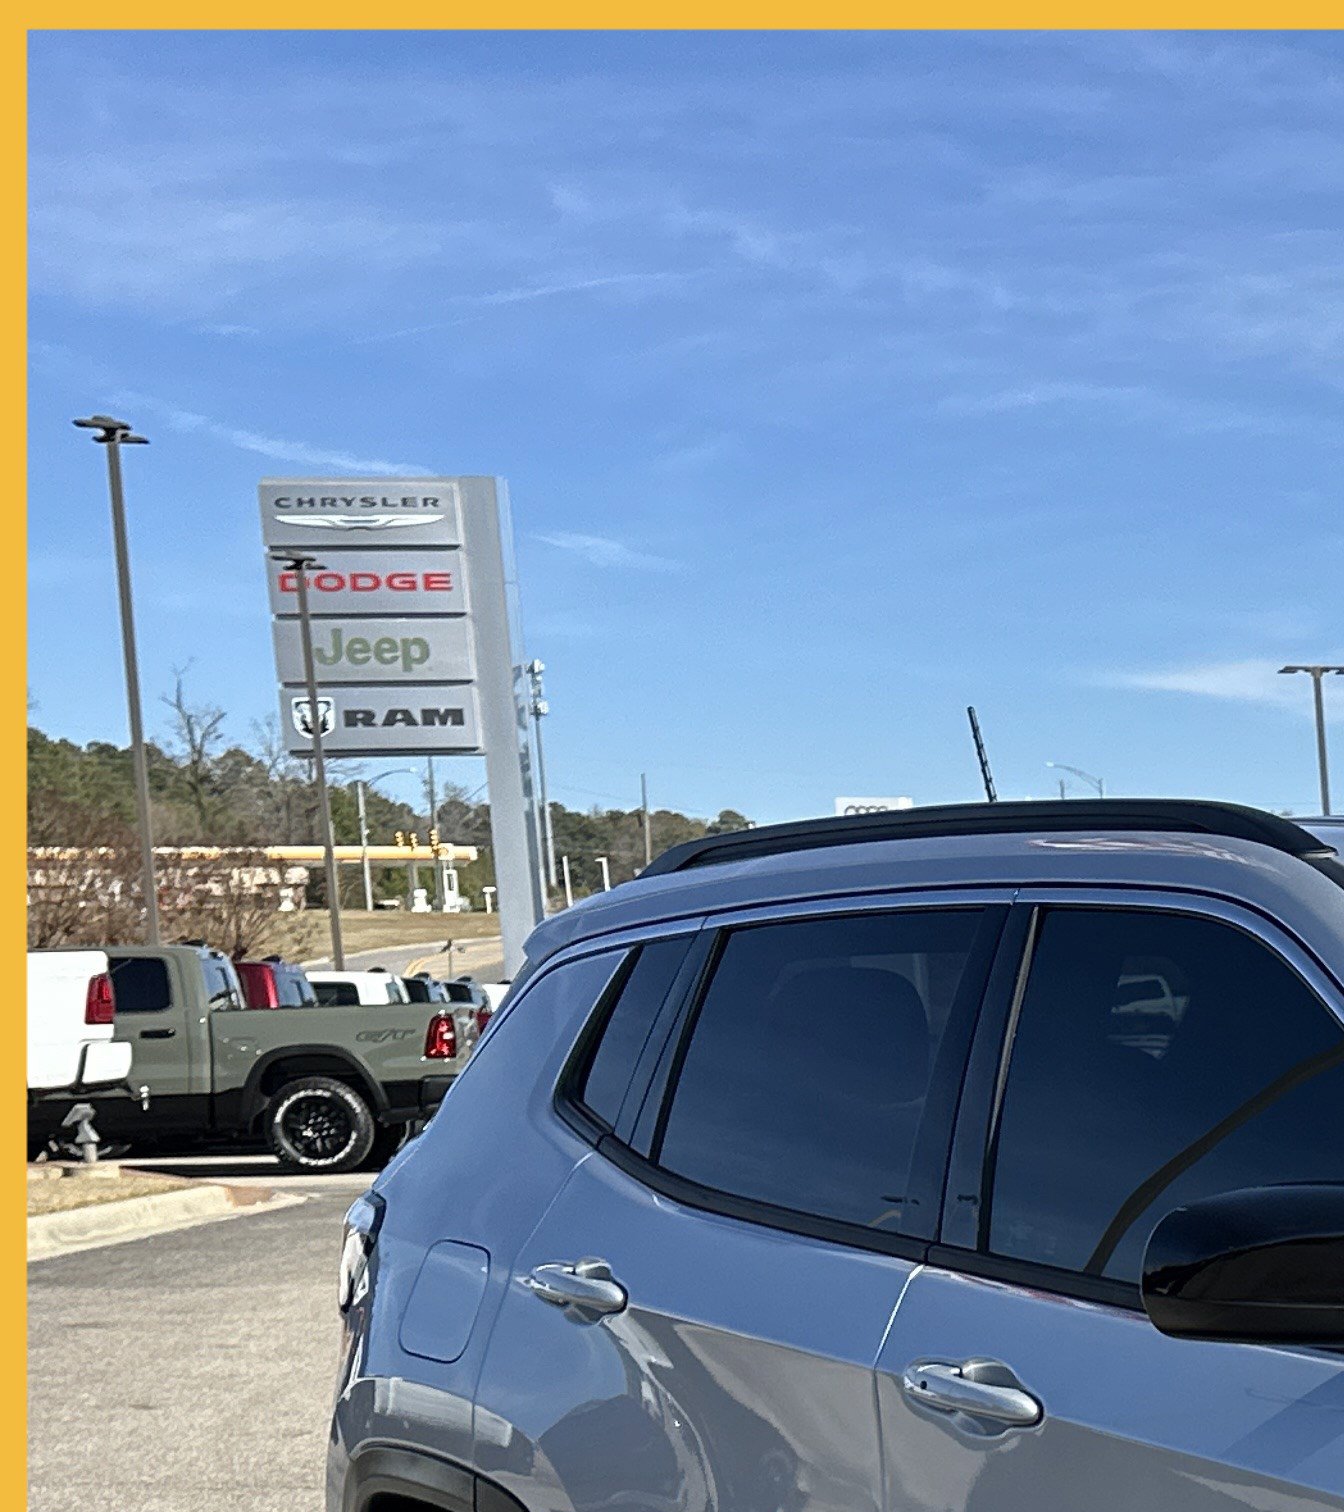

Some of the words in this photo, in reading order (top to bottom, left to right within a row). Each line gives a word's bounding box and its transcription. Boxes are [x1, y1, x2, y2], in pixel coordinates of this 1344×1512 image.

[273, 496, 440, 509] CHRYSLER
[277, 572, 454, 593] DODGE
[314, 628, 431, 672] Jeep
[343, 707, 465, 728] RAM
